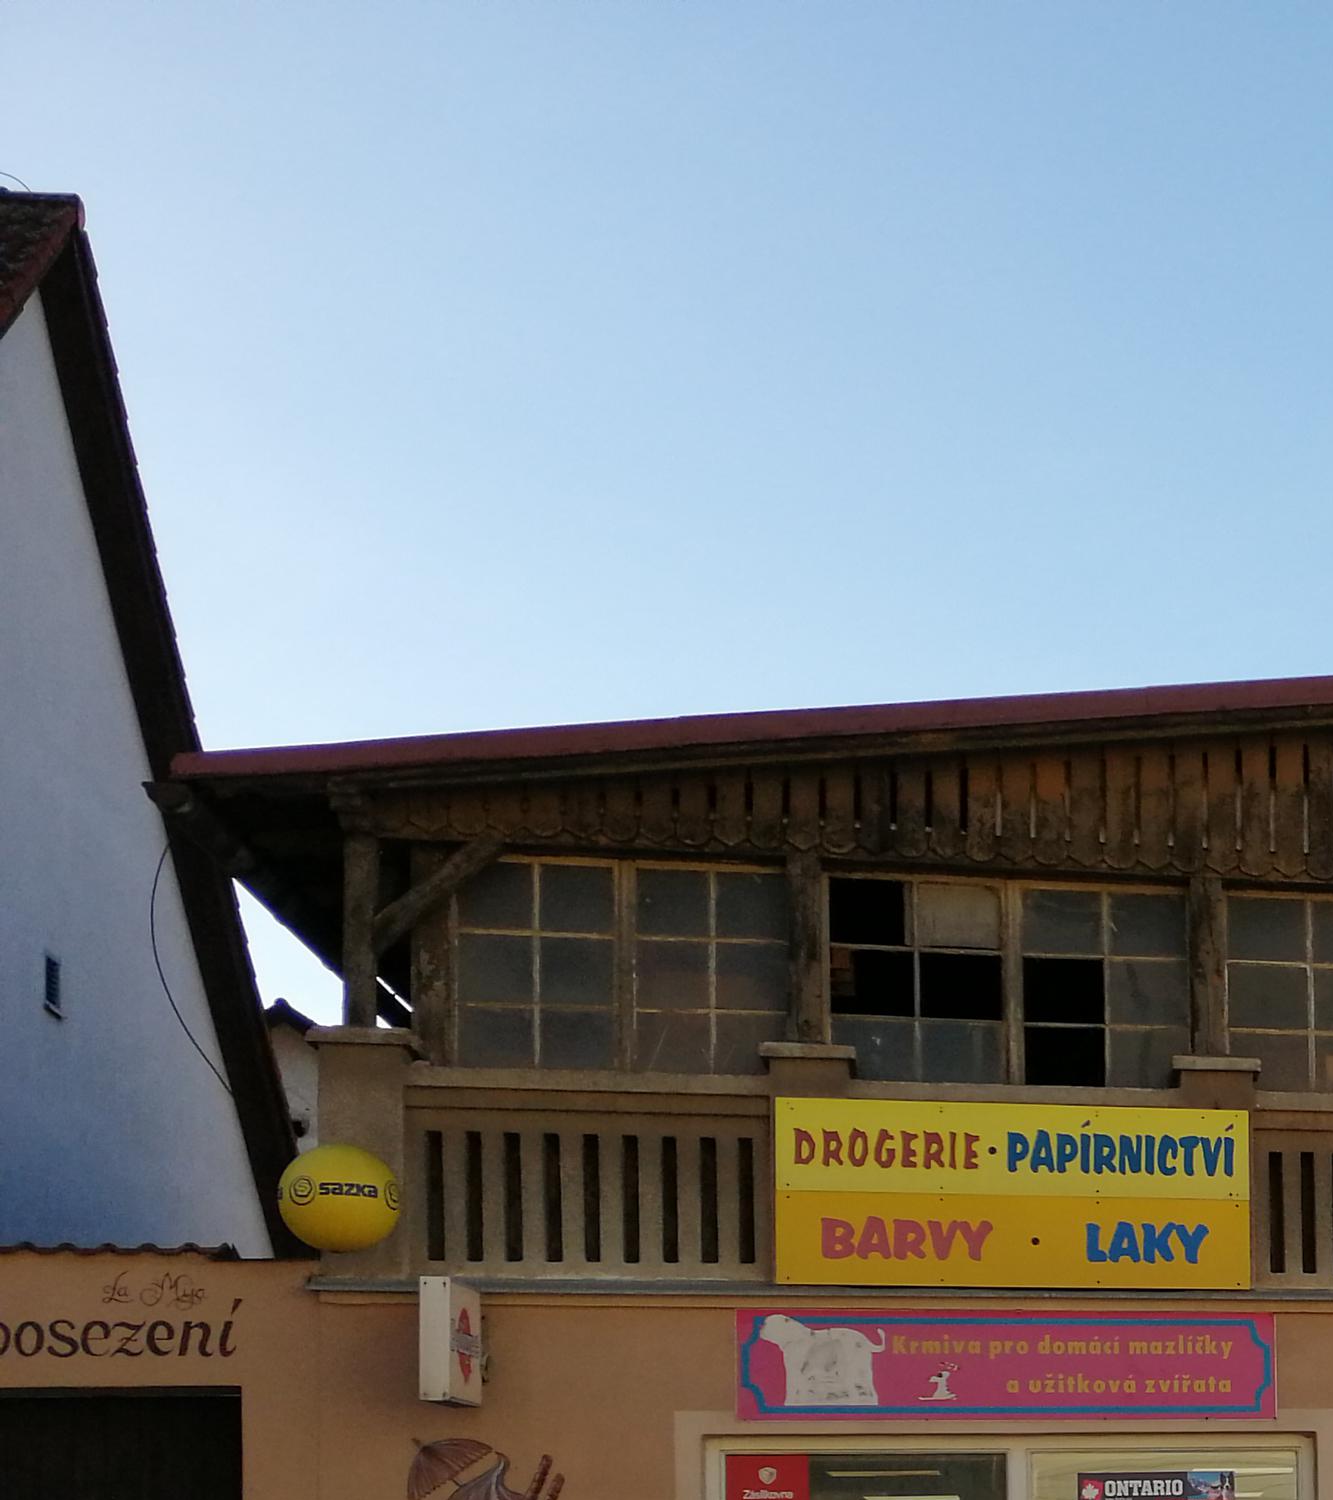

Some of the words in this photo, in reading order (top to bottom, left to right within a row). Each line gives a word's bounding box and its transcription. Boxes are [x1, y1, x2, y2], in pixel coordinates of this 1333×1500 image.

[793, 1127, 981, 1170] DROGERIE
[1006, 1119, 1235, 1178] PAPÍRNICTVÍ
[820, 1216, 994, 1261] BARVY
[1085, 1221, 1210, 1265] LAKY
[892, 1334, 981, 1355] Krmiva
[989, 1339, 1030, 1360] pro
[1038, 1334, 1120, 1355] domácí
[1128, 1334, 1233, 1360] mazlíčky
[1006, 1379, 1020, 1394] a
[1028, 1373, 1137, 1394] užitková
[1145, 1374, 1232, 1394] zvířata
[1104, 1478, 1184, 1498] ONTARIO
